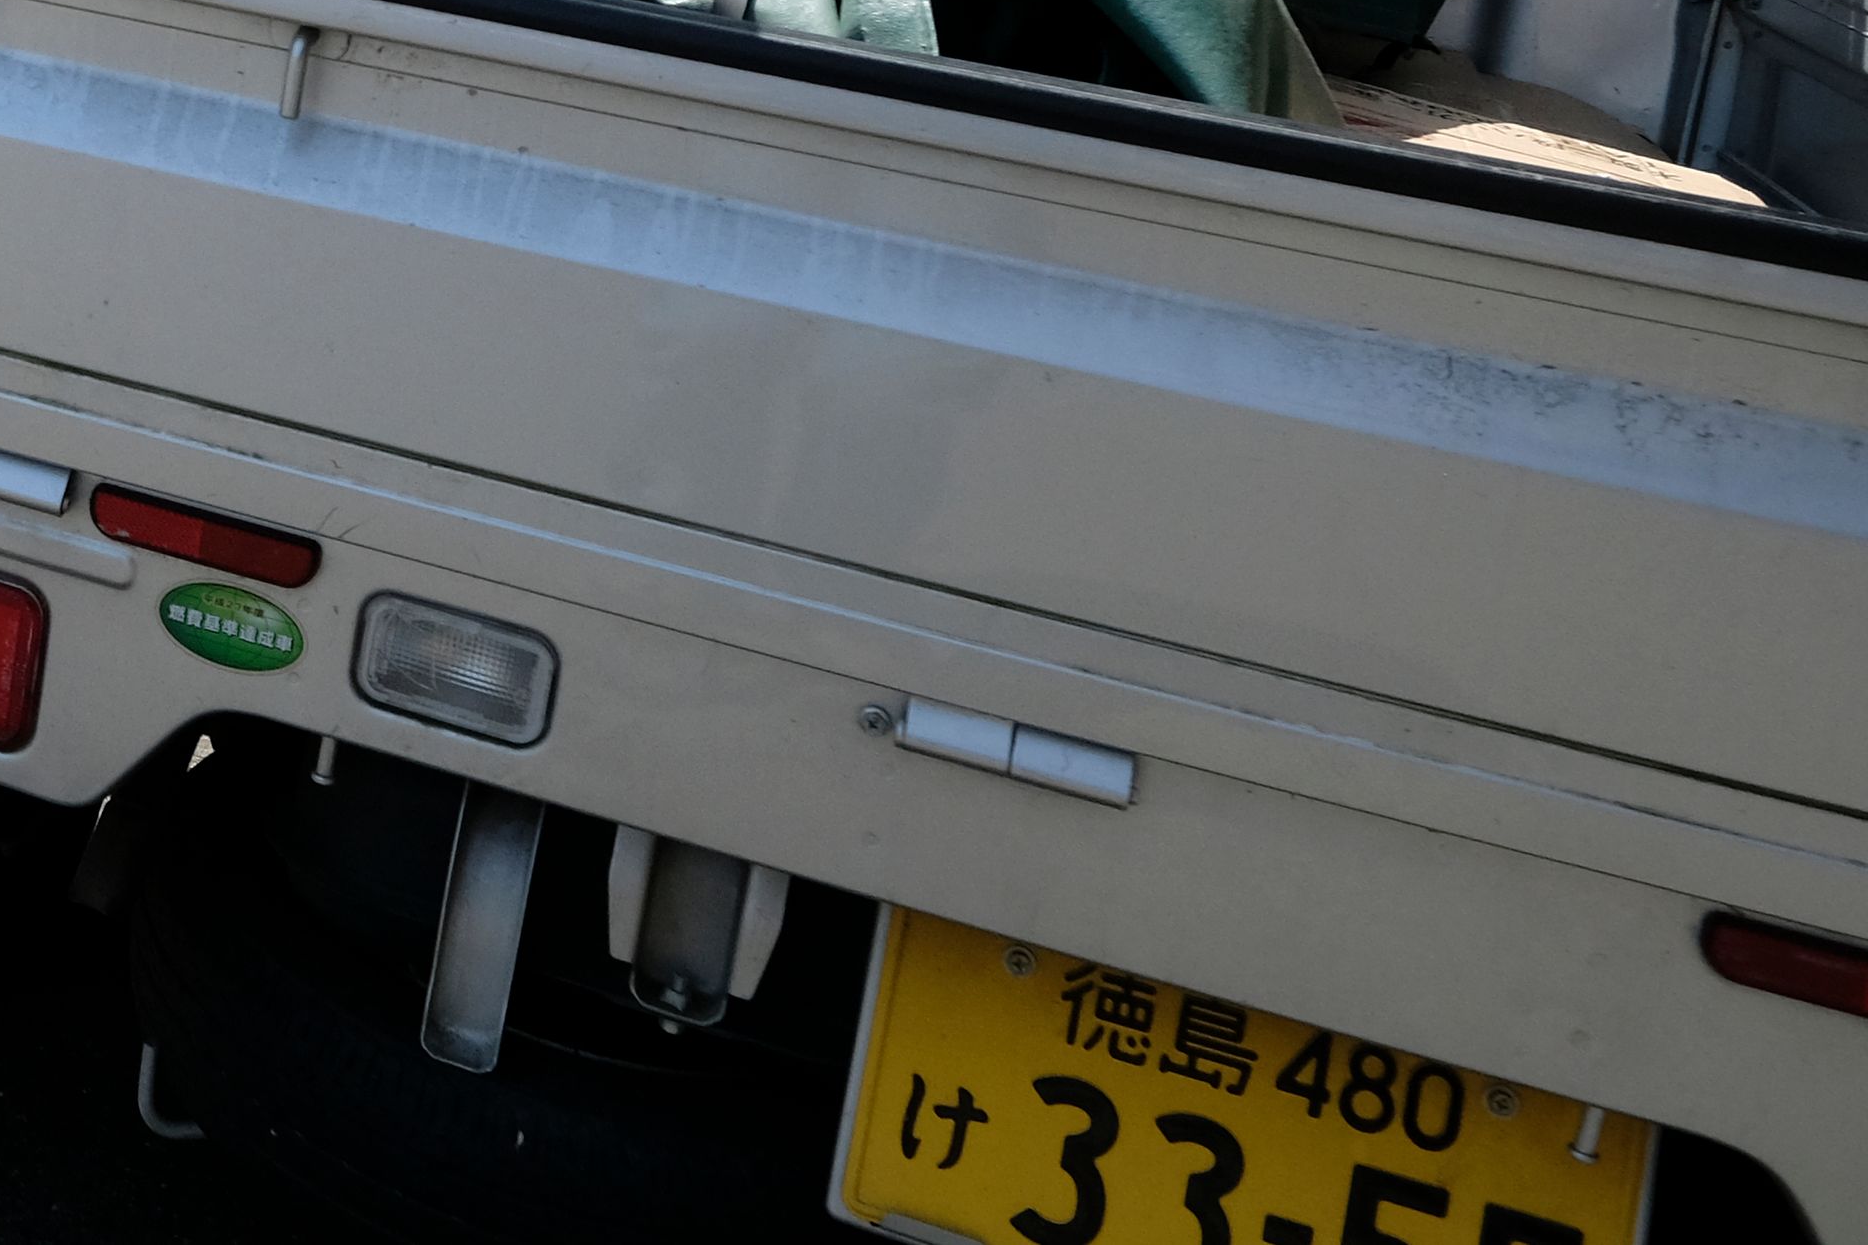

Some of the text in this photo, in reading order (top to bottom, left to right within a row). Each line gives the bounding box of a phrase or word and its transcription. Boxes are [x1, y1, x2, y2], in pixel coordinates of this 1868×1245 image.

[901, 1073, 989, 1170] け
[1061, 961, 1466, 1153] 徳島 480
